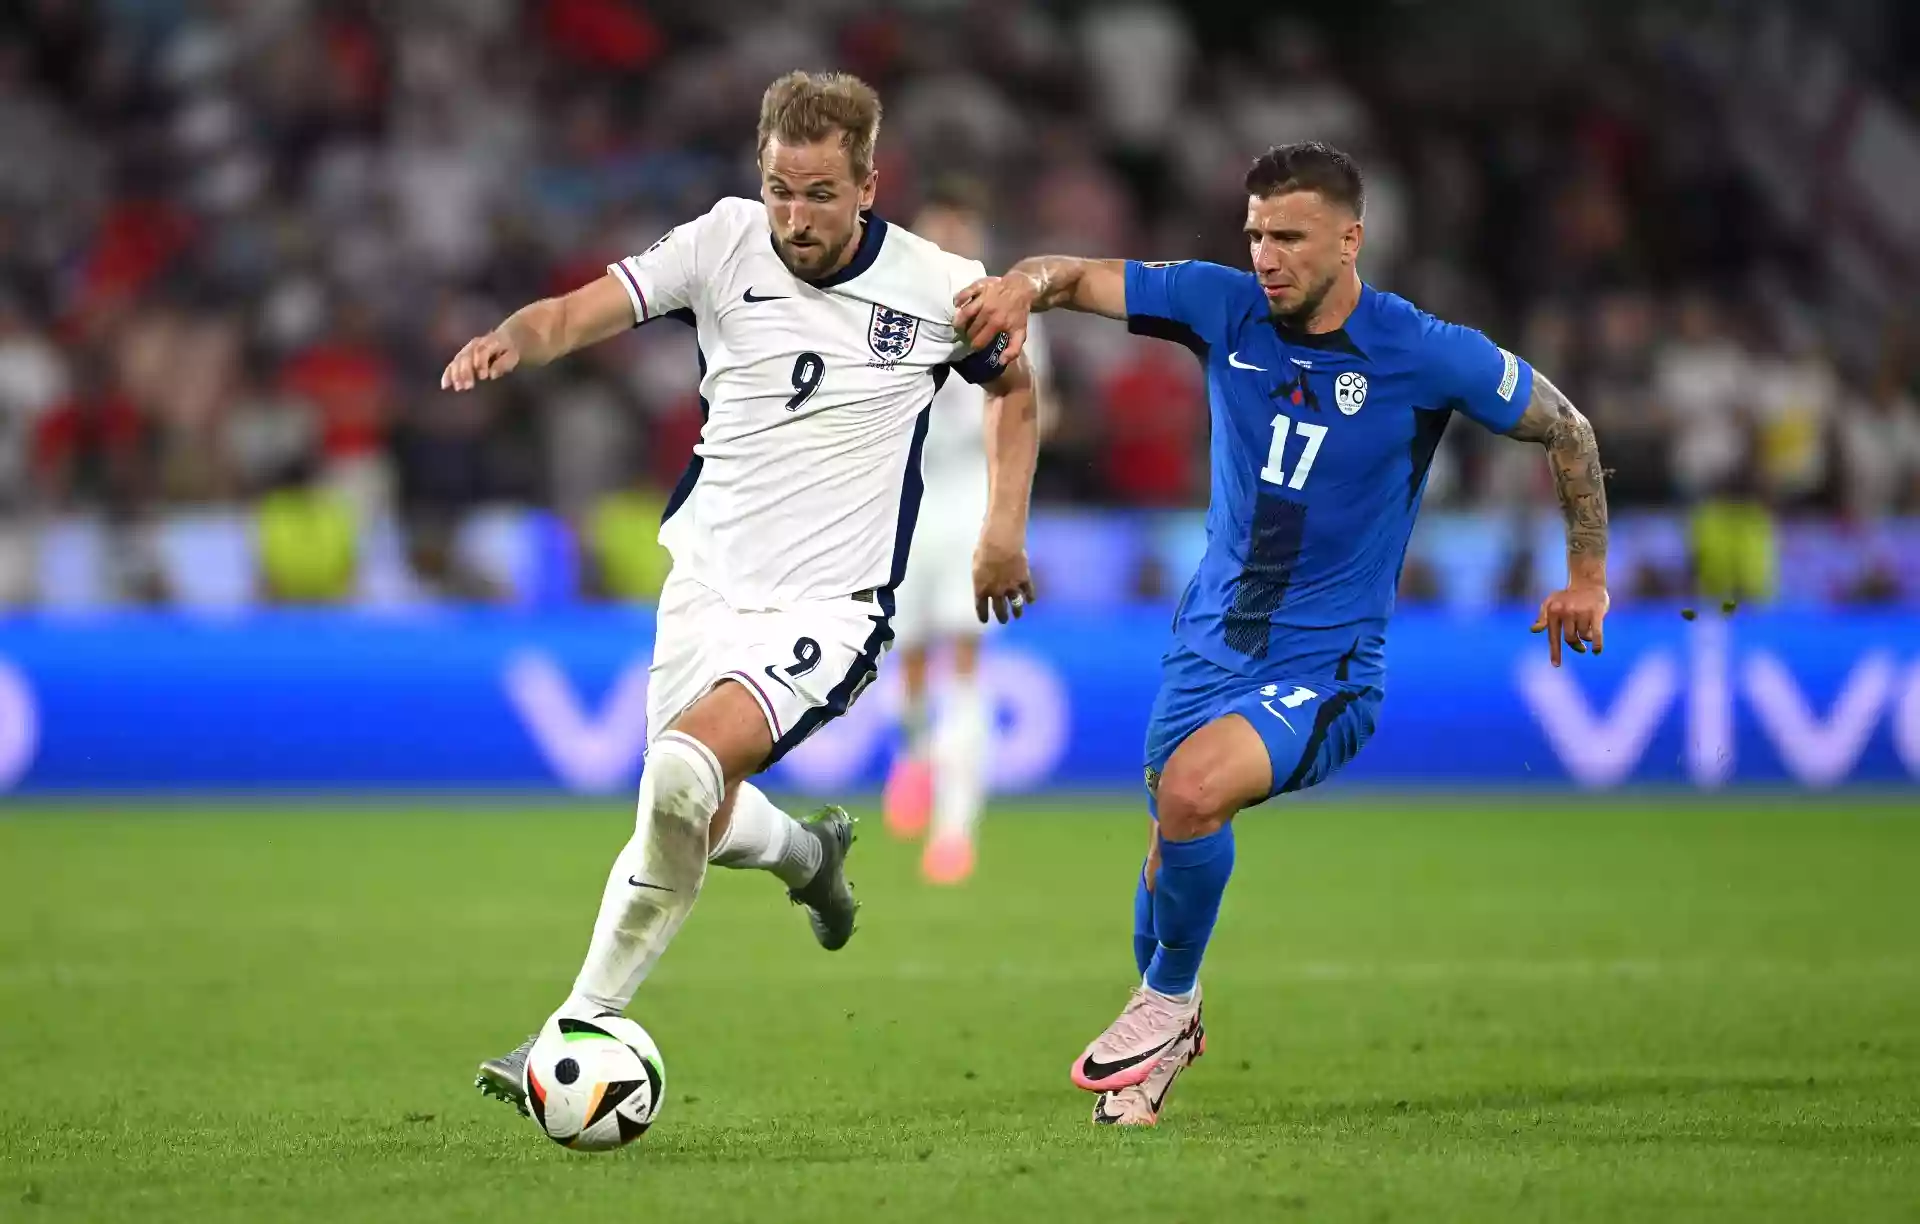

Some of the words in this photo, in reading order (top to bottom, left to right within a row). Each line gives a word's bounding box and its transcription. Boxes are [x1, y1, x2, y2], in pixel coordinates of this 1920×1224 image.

[785, 351, 827, 412] 9
[1259, 413, 1329, 491] 17
[783, 636, 822, 680] 9
[1519, 612, 1920, 792] viv
